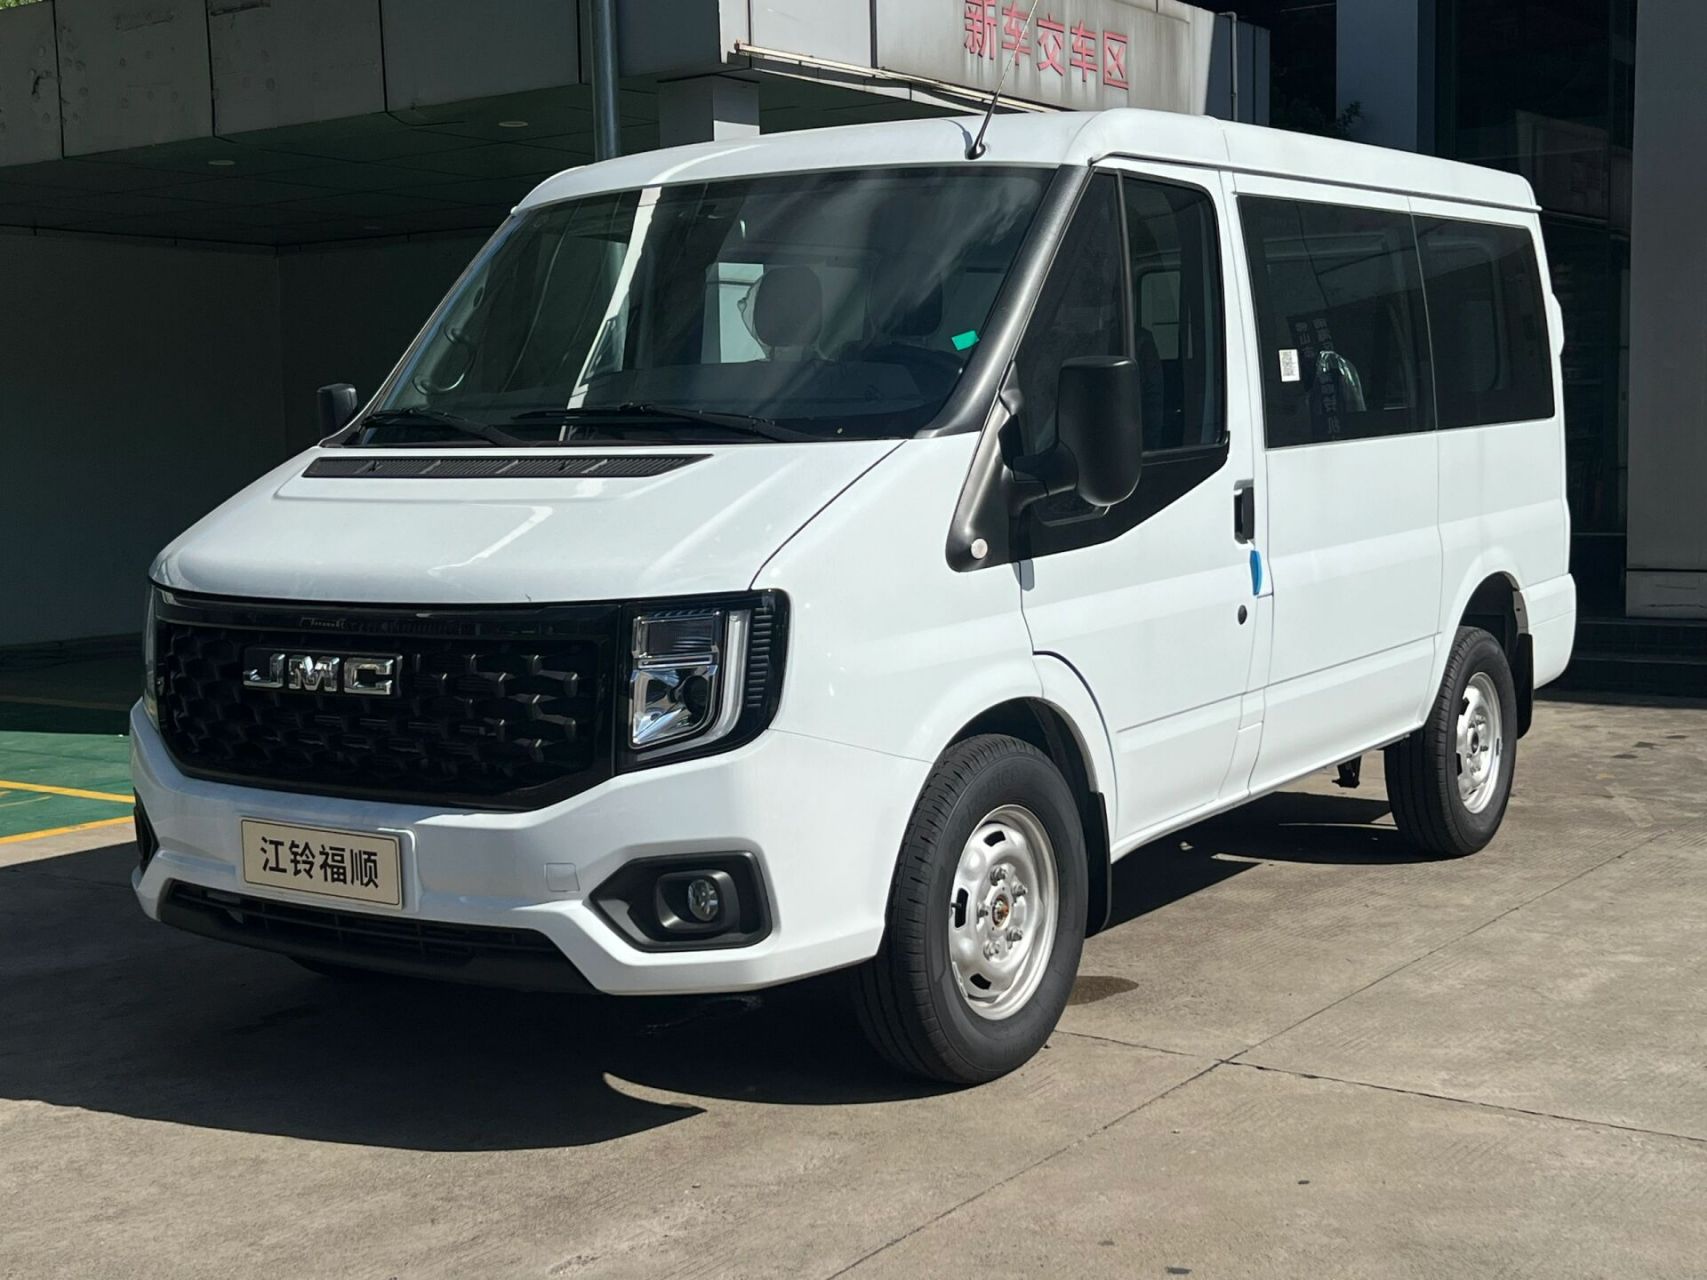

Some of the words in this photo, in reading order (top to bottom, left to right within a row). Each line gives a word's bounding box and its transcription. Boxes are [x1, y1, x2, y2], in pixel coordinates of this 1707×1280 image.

[964, 0, 1129, 90] 新车交车区
[243, 653, 394, 695] JMC
[260, 836, 379, 889] 江铃福顺
